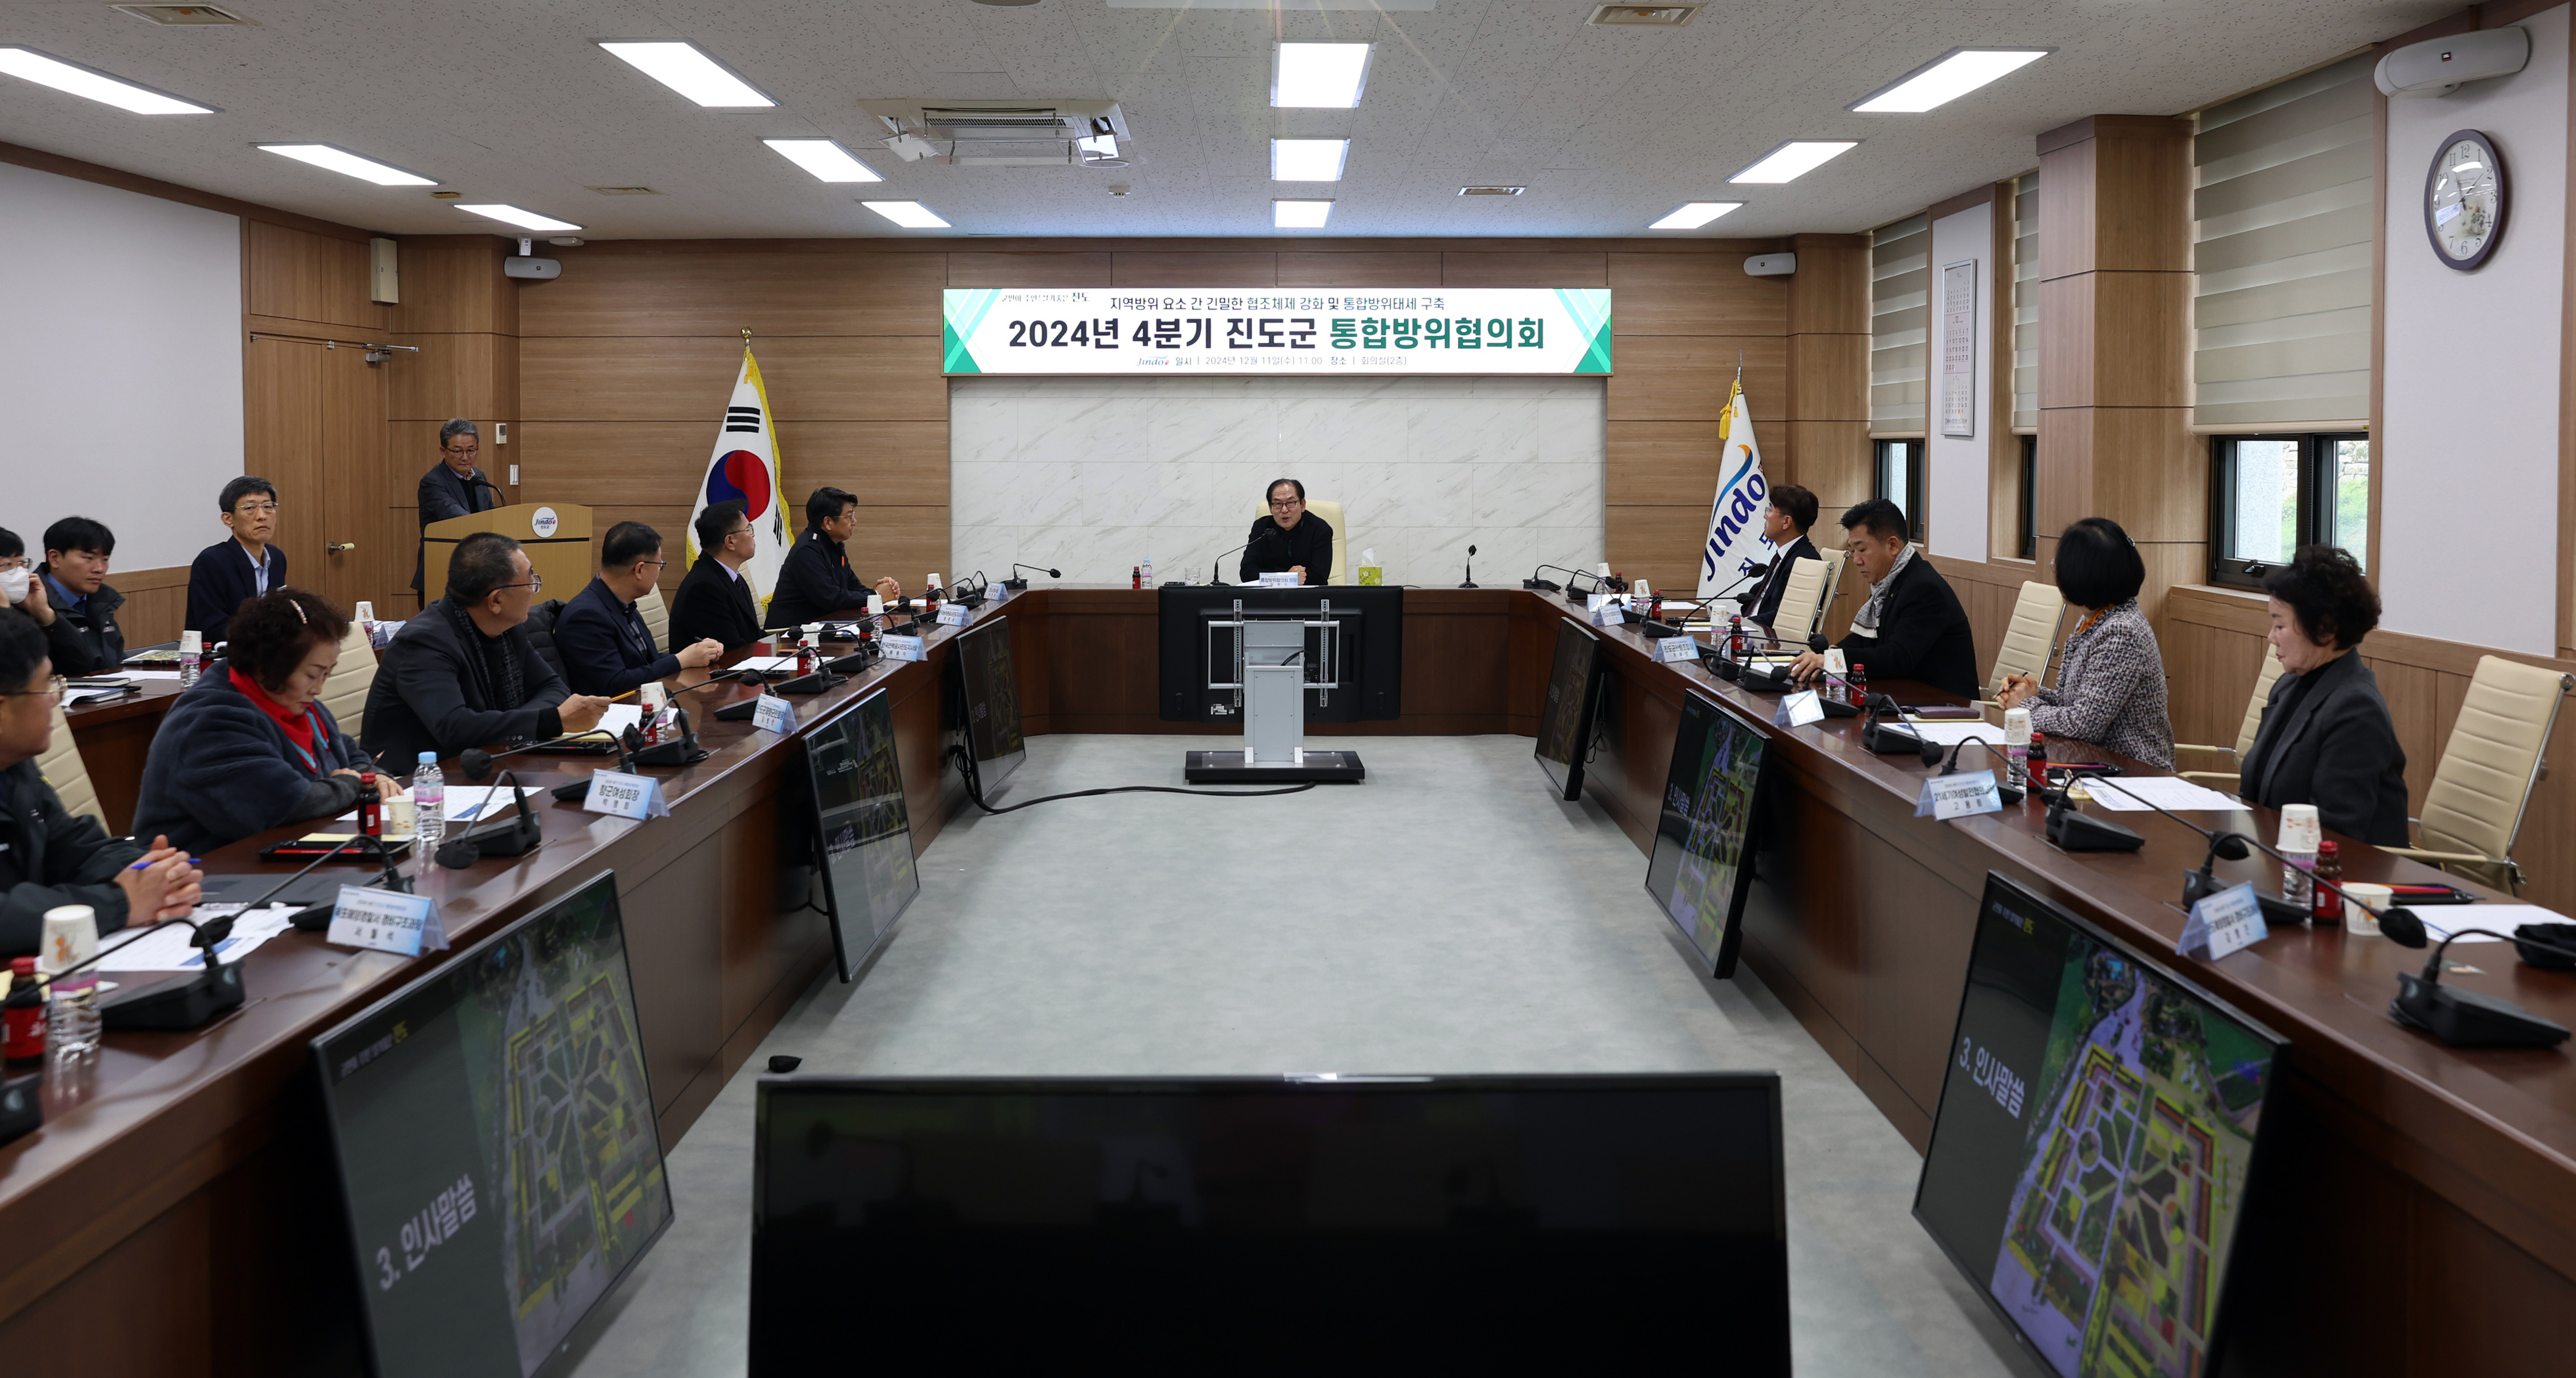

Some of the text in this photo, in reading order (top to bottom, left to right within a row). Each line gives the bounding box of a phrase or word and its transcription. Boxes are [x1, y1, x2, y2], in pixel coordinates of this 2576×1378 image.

[2460, 144, 2470, 159] 12
[2477, 149, 2481, 162] 1
[2449, 152, 2456, 166] 11
[2439, 172, 2448, 186] 10
[2487, 166, 2493, 179] 2
[2491, 189, 2496, 203] 3
[2434, 199, 2440, 210] 9
[2485, 214, 2493, 227] 4
[2448, 235, 2454, 249] 7
[2475, 233, 2481, 247] 5
[2461, 241, 2468, 255] 6
[1071, 292, 1090, 302] 진도
[1111, 297, 1445, 310] 지역방위 요소 간 긴밀한 협조체제 강화 및 통합방위태세 구축
[1009, 317, 1543, 349] 2024년 4분기 진도군 통합방위협의회
[1136, 356, 1165, 366] Jindo
[1175, 357, 1192, 366] 일시
[1206, 356, 1236, 365] 2024년
[1240, 356, 1257, 365] 12월
[1262, 356, 1295, 365] 11일(수)
[1330, 356, 1347, 365] 장소
[1361, 356, 1407, 365] 회의실(2층)
[1704, 473, 1766, 582] Jindo
[599, 784, 640, 802] 향군여성회장
[1959, 1037, 2025, 1119] 3. 인사말씀
[376, 1172, 477, 1291] 3. 인사말씀
